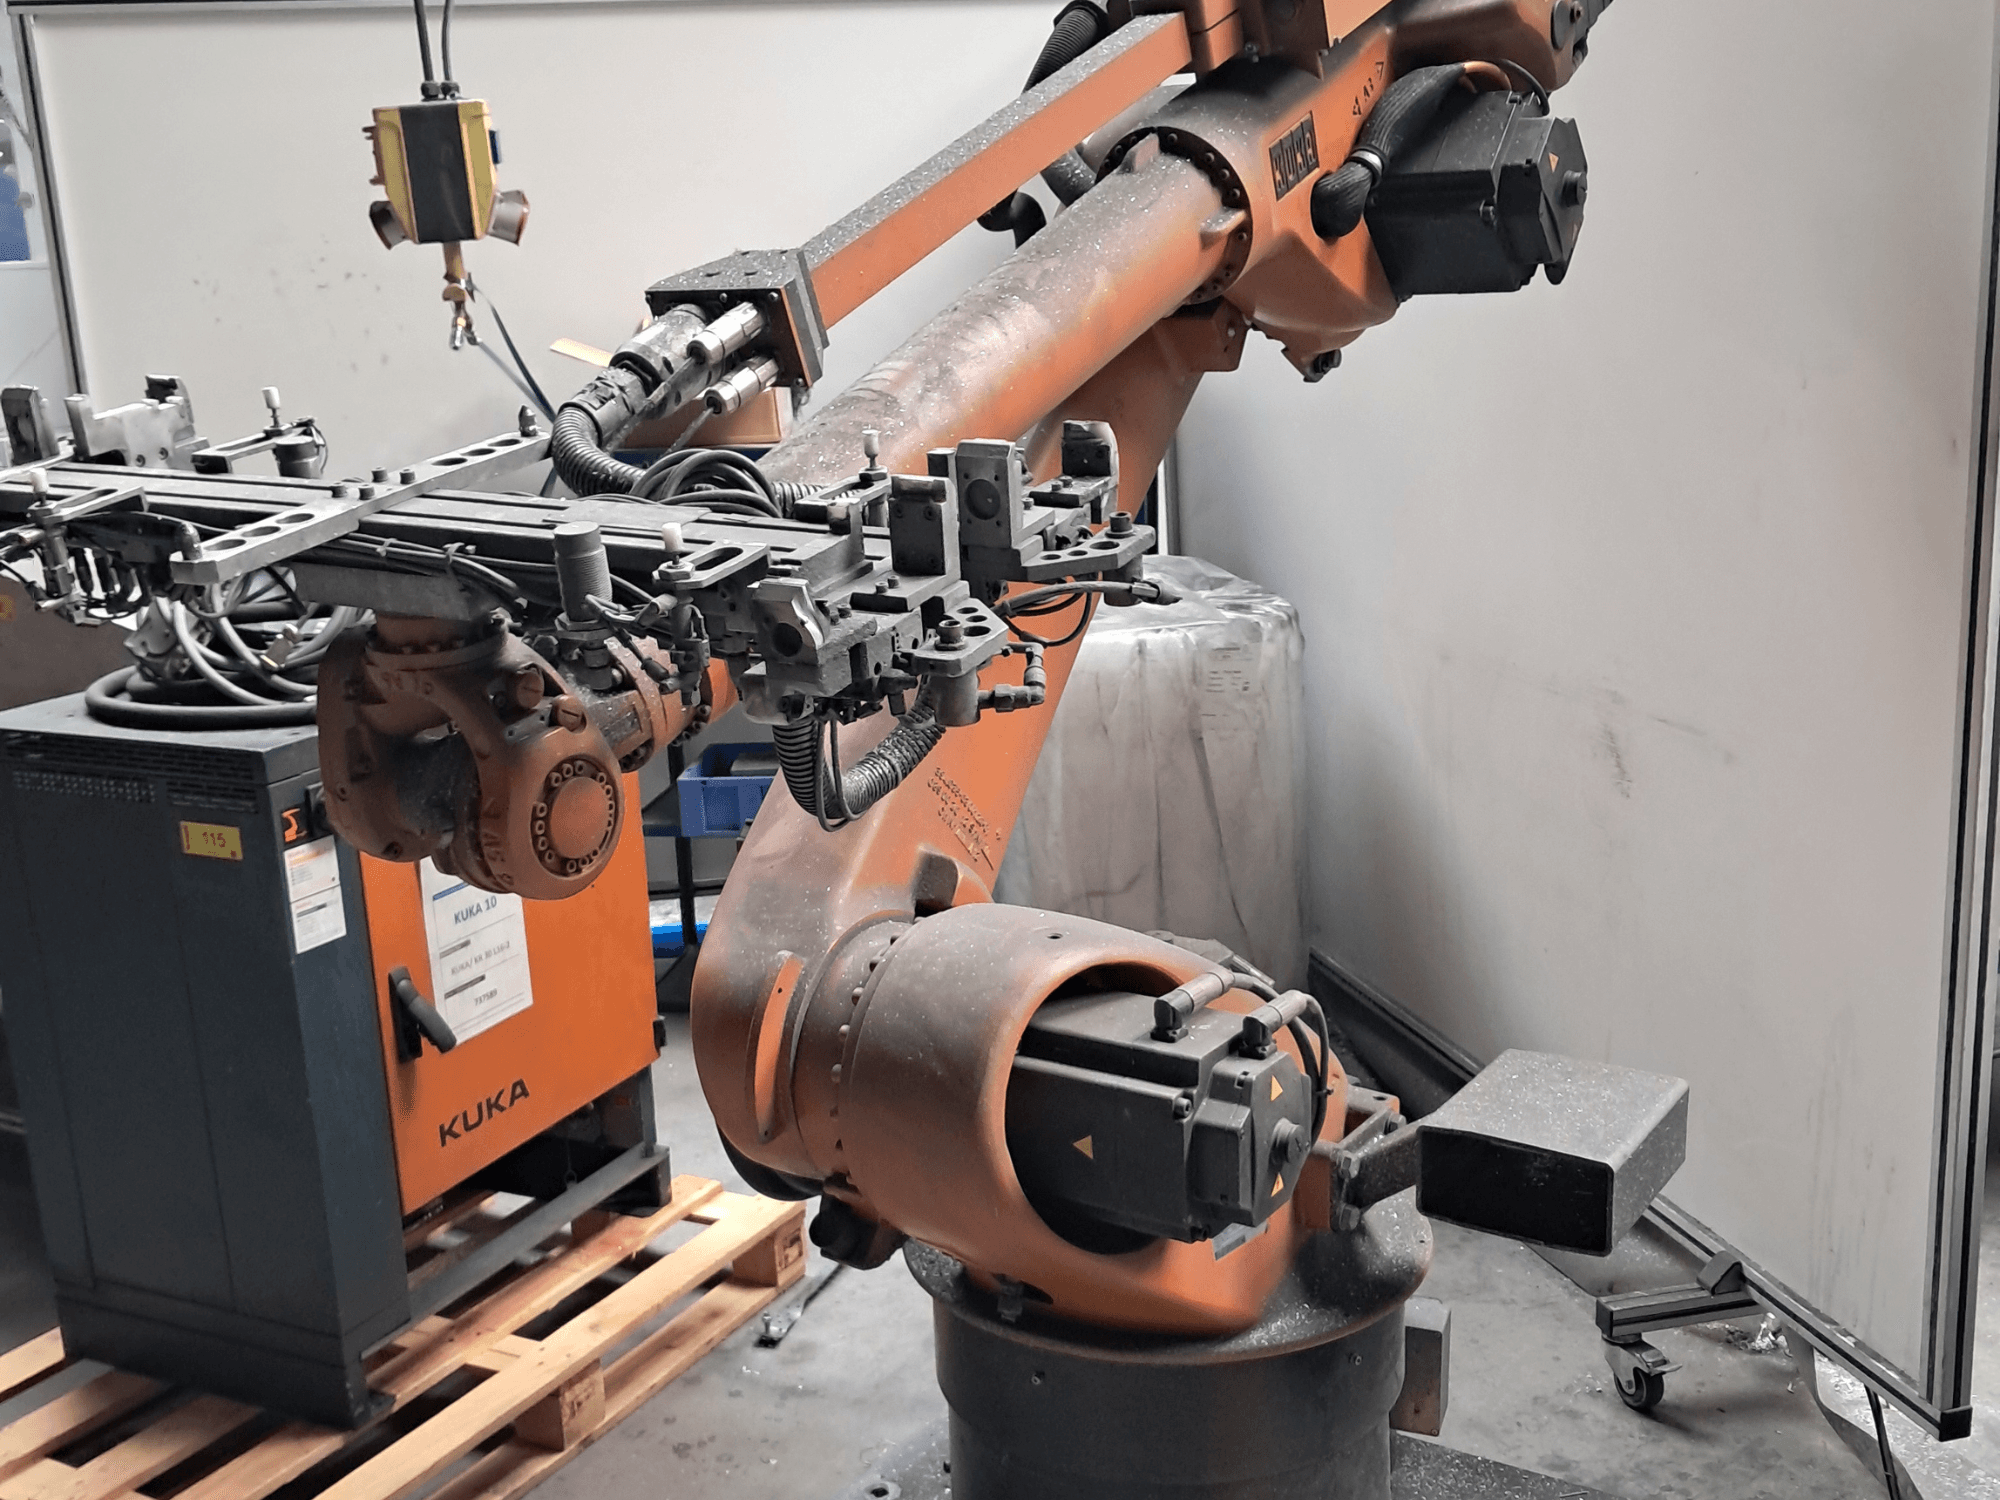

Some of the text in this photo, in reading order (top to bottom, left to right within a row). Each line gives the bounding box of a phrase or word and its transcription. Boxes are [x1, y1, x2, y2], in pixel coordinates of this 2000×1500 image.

[1273, 129, 1316, 192] KUKA
[454, 895, 497, 924] KUKA 10
[439, 1079, 529, 1147] KUKA
